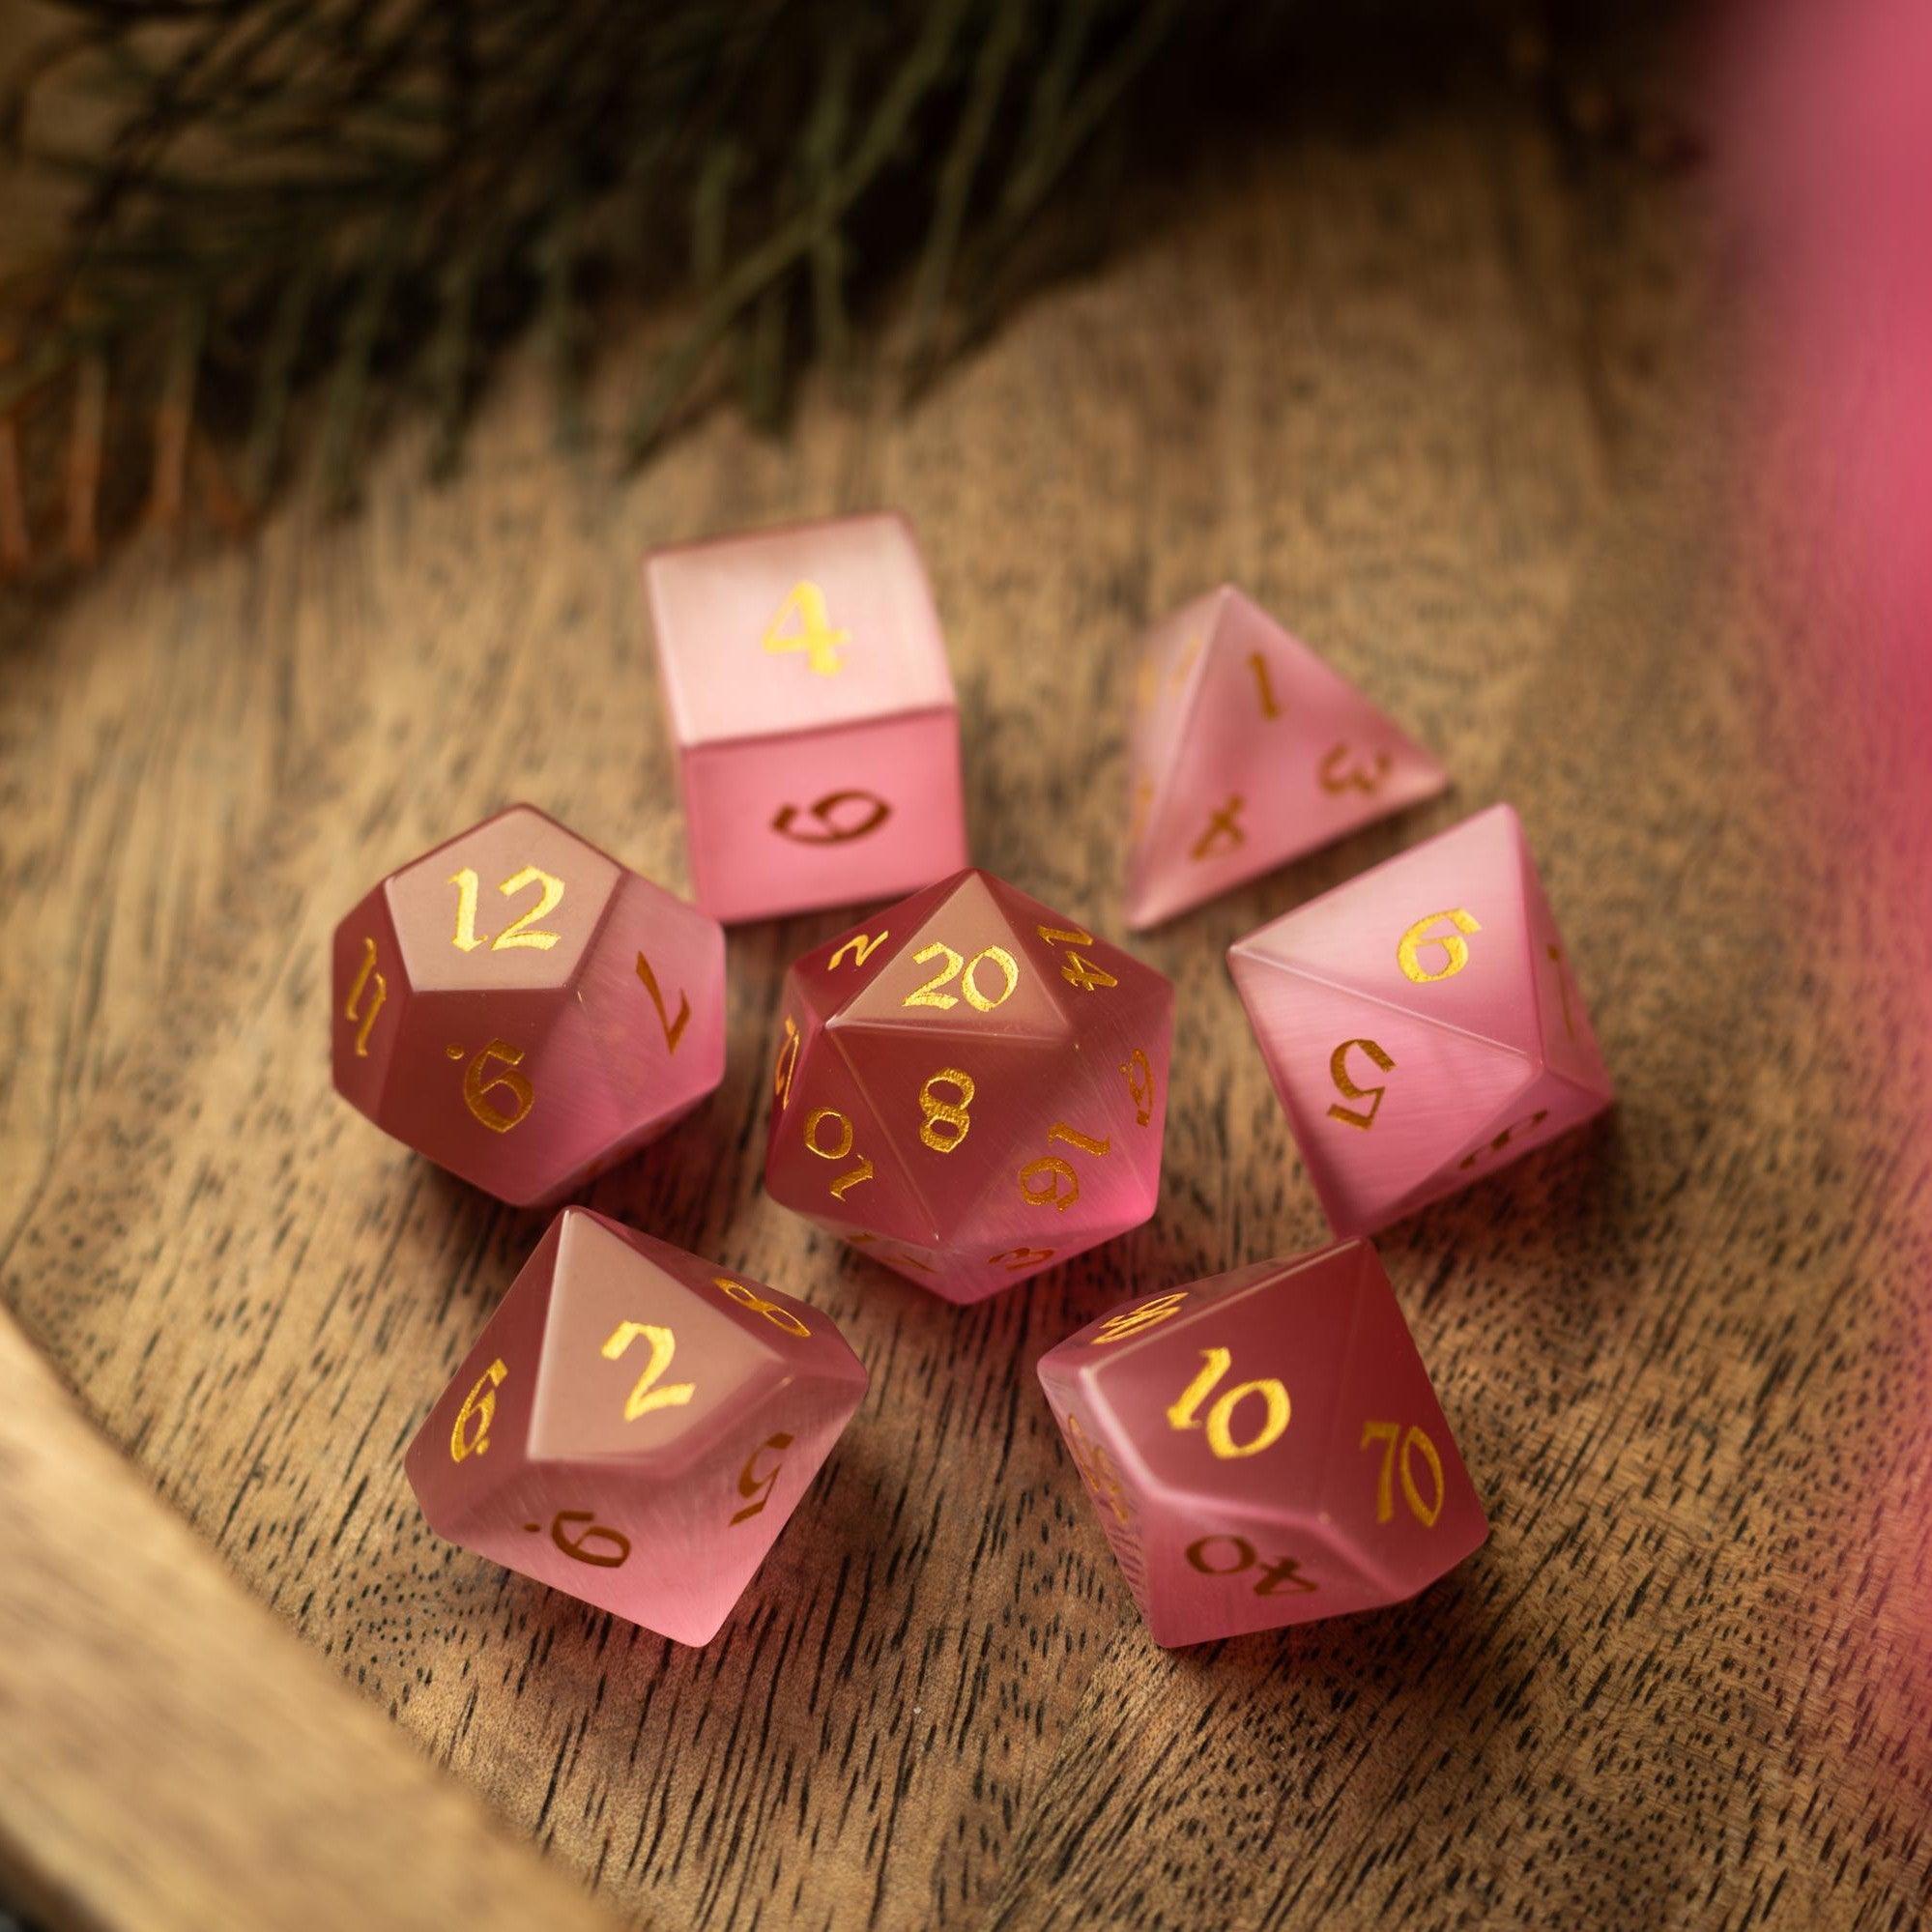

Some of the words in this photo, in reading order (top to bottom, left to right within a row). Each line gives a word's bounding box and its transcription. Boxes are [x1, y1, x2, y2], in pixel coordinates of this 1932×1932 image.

[762, 580, 851, 675] 4
[1247, 650, 1282, 720] 1
[448, 865, 565, 952] 12
[828, 929, 889, 970] 2
[636, 950, 691, 1055] 7
[902, 940, 1020, 1013] 20
[1035, 924, 1118, 992] 14
[919, 1067, 976, 1154] 8
[1326, 1038, 1397, 1131] 5
[804, 1106, 875, 1202] 10
[1019, 1121, 1110, 1213] 16
[712, 1277, 813, 1339] 8
[601, 1319, 697, 1423] 2
[1166, 1346, 1292, 1460] 10
[729, 1431, 794, 1528] 5
[1361, 1421, 1445, 1528] 70
[1186, 1533, 1318, 1597] 40
